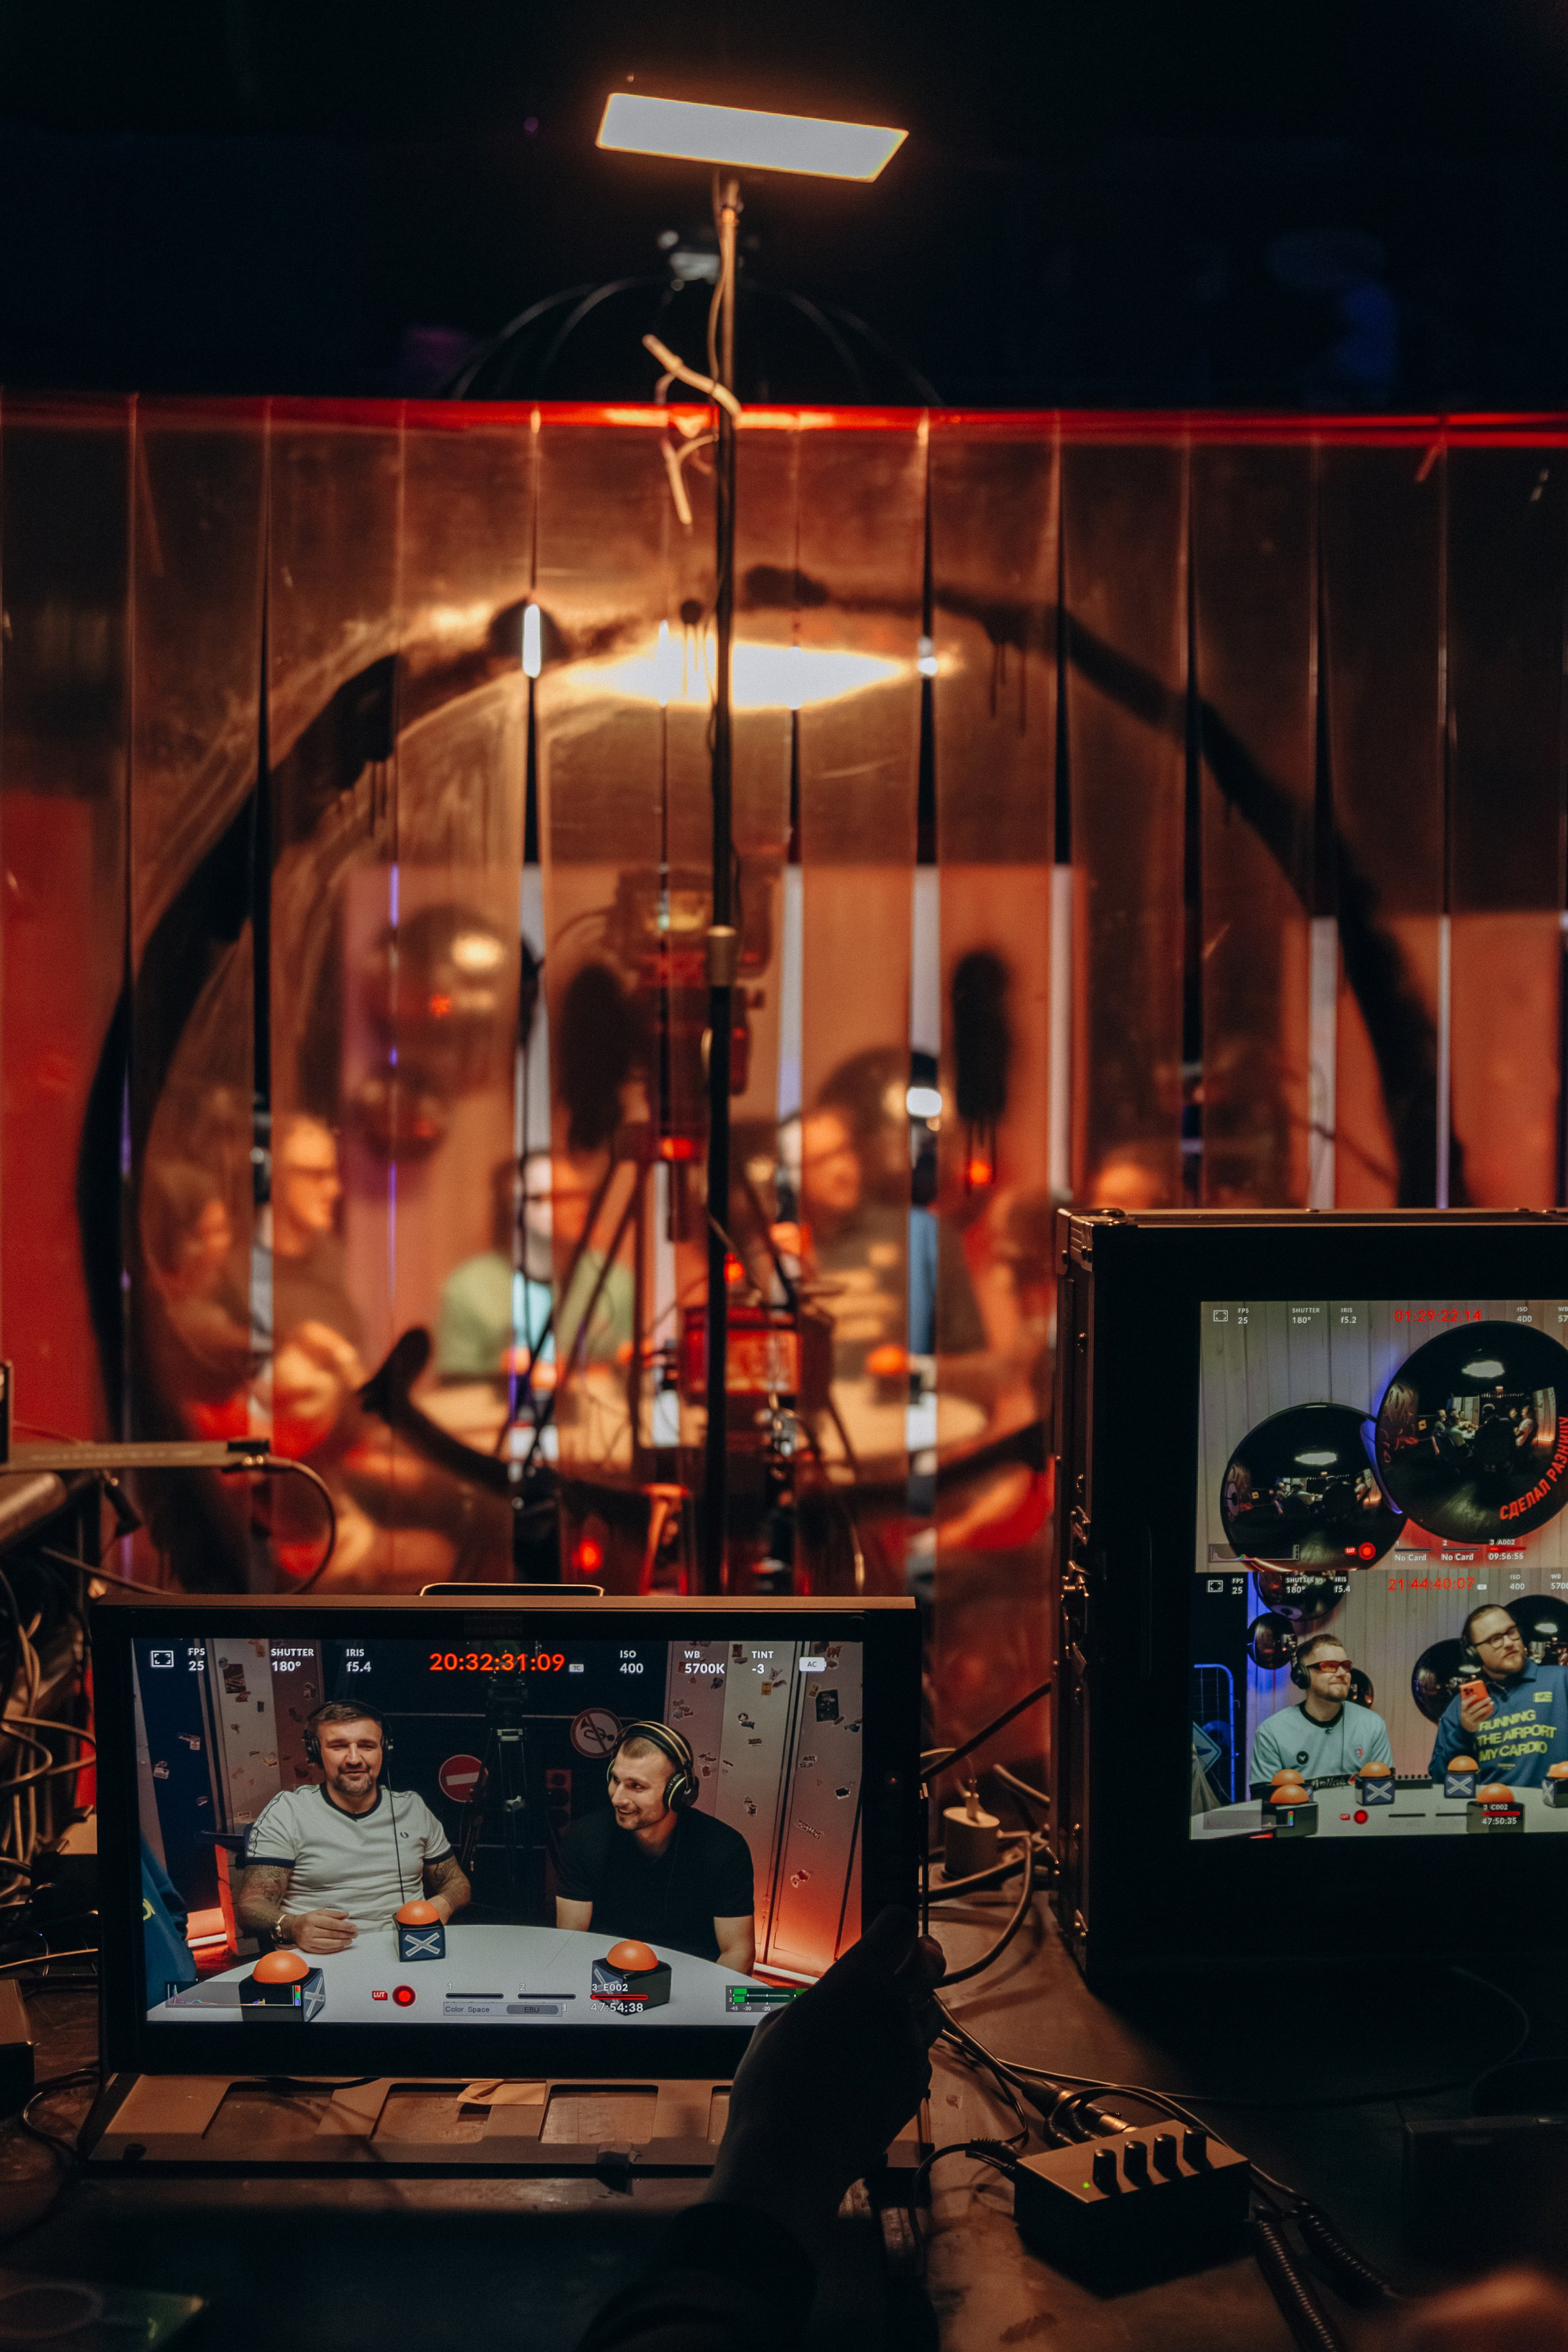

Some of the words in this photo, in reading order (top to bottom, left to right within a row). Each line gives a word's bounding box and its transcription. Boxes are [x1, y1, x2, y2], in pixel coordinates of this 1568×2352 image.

[1394, 1309, 1482, 1322] 01:29:22:14
[1499, 1479, 1551, 1520] СДЕЛАЛ
[1388, 1577, 1476, 1591] 21:44:40:07
[187, 1647, 205, 1656] FPS
[271, 1648, 314, 1657] SHUTTER
[346, 1648, 365, 1657] IRIS
[619, 1649, 637, 1659] ISO
[684, 1650, 701, 1659] WB
[751, 1650, 774, 1659] TINT
[188, 1660, 205, 1672] 25
[271, 1660, 301, 1672] 180°
[345, 1660, 372, 1672] f5.4
[429, 1653, 565, 1672] 20:32:31:09
[619, 1662, 644, 1674] 400
[684, 1662, 725, 1675] 5700K
[752, 1664, 765, 1674] -3
[1479, 1709, 1537, 1732] RUNNING
[1476, 1732, 1502, 1746] THE
[1503, 1724, 1558, 1742] AIRPORT
[1479, 1747, 1499, 1762] MY
[1499, 1741, 1548, 1757] CARDIO
[467, 2005, 490, 2016] Space
[524, 2005, 540, 2014] EBU
[590, 2002, 644, 2013] 47:54:38
